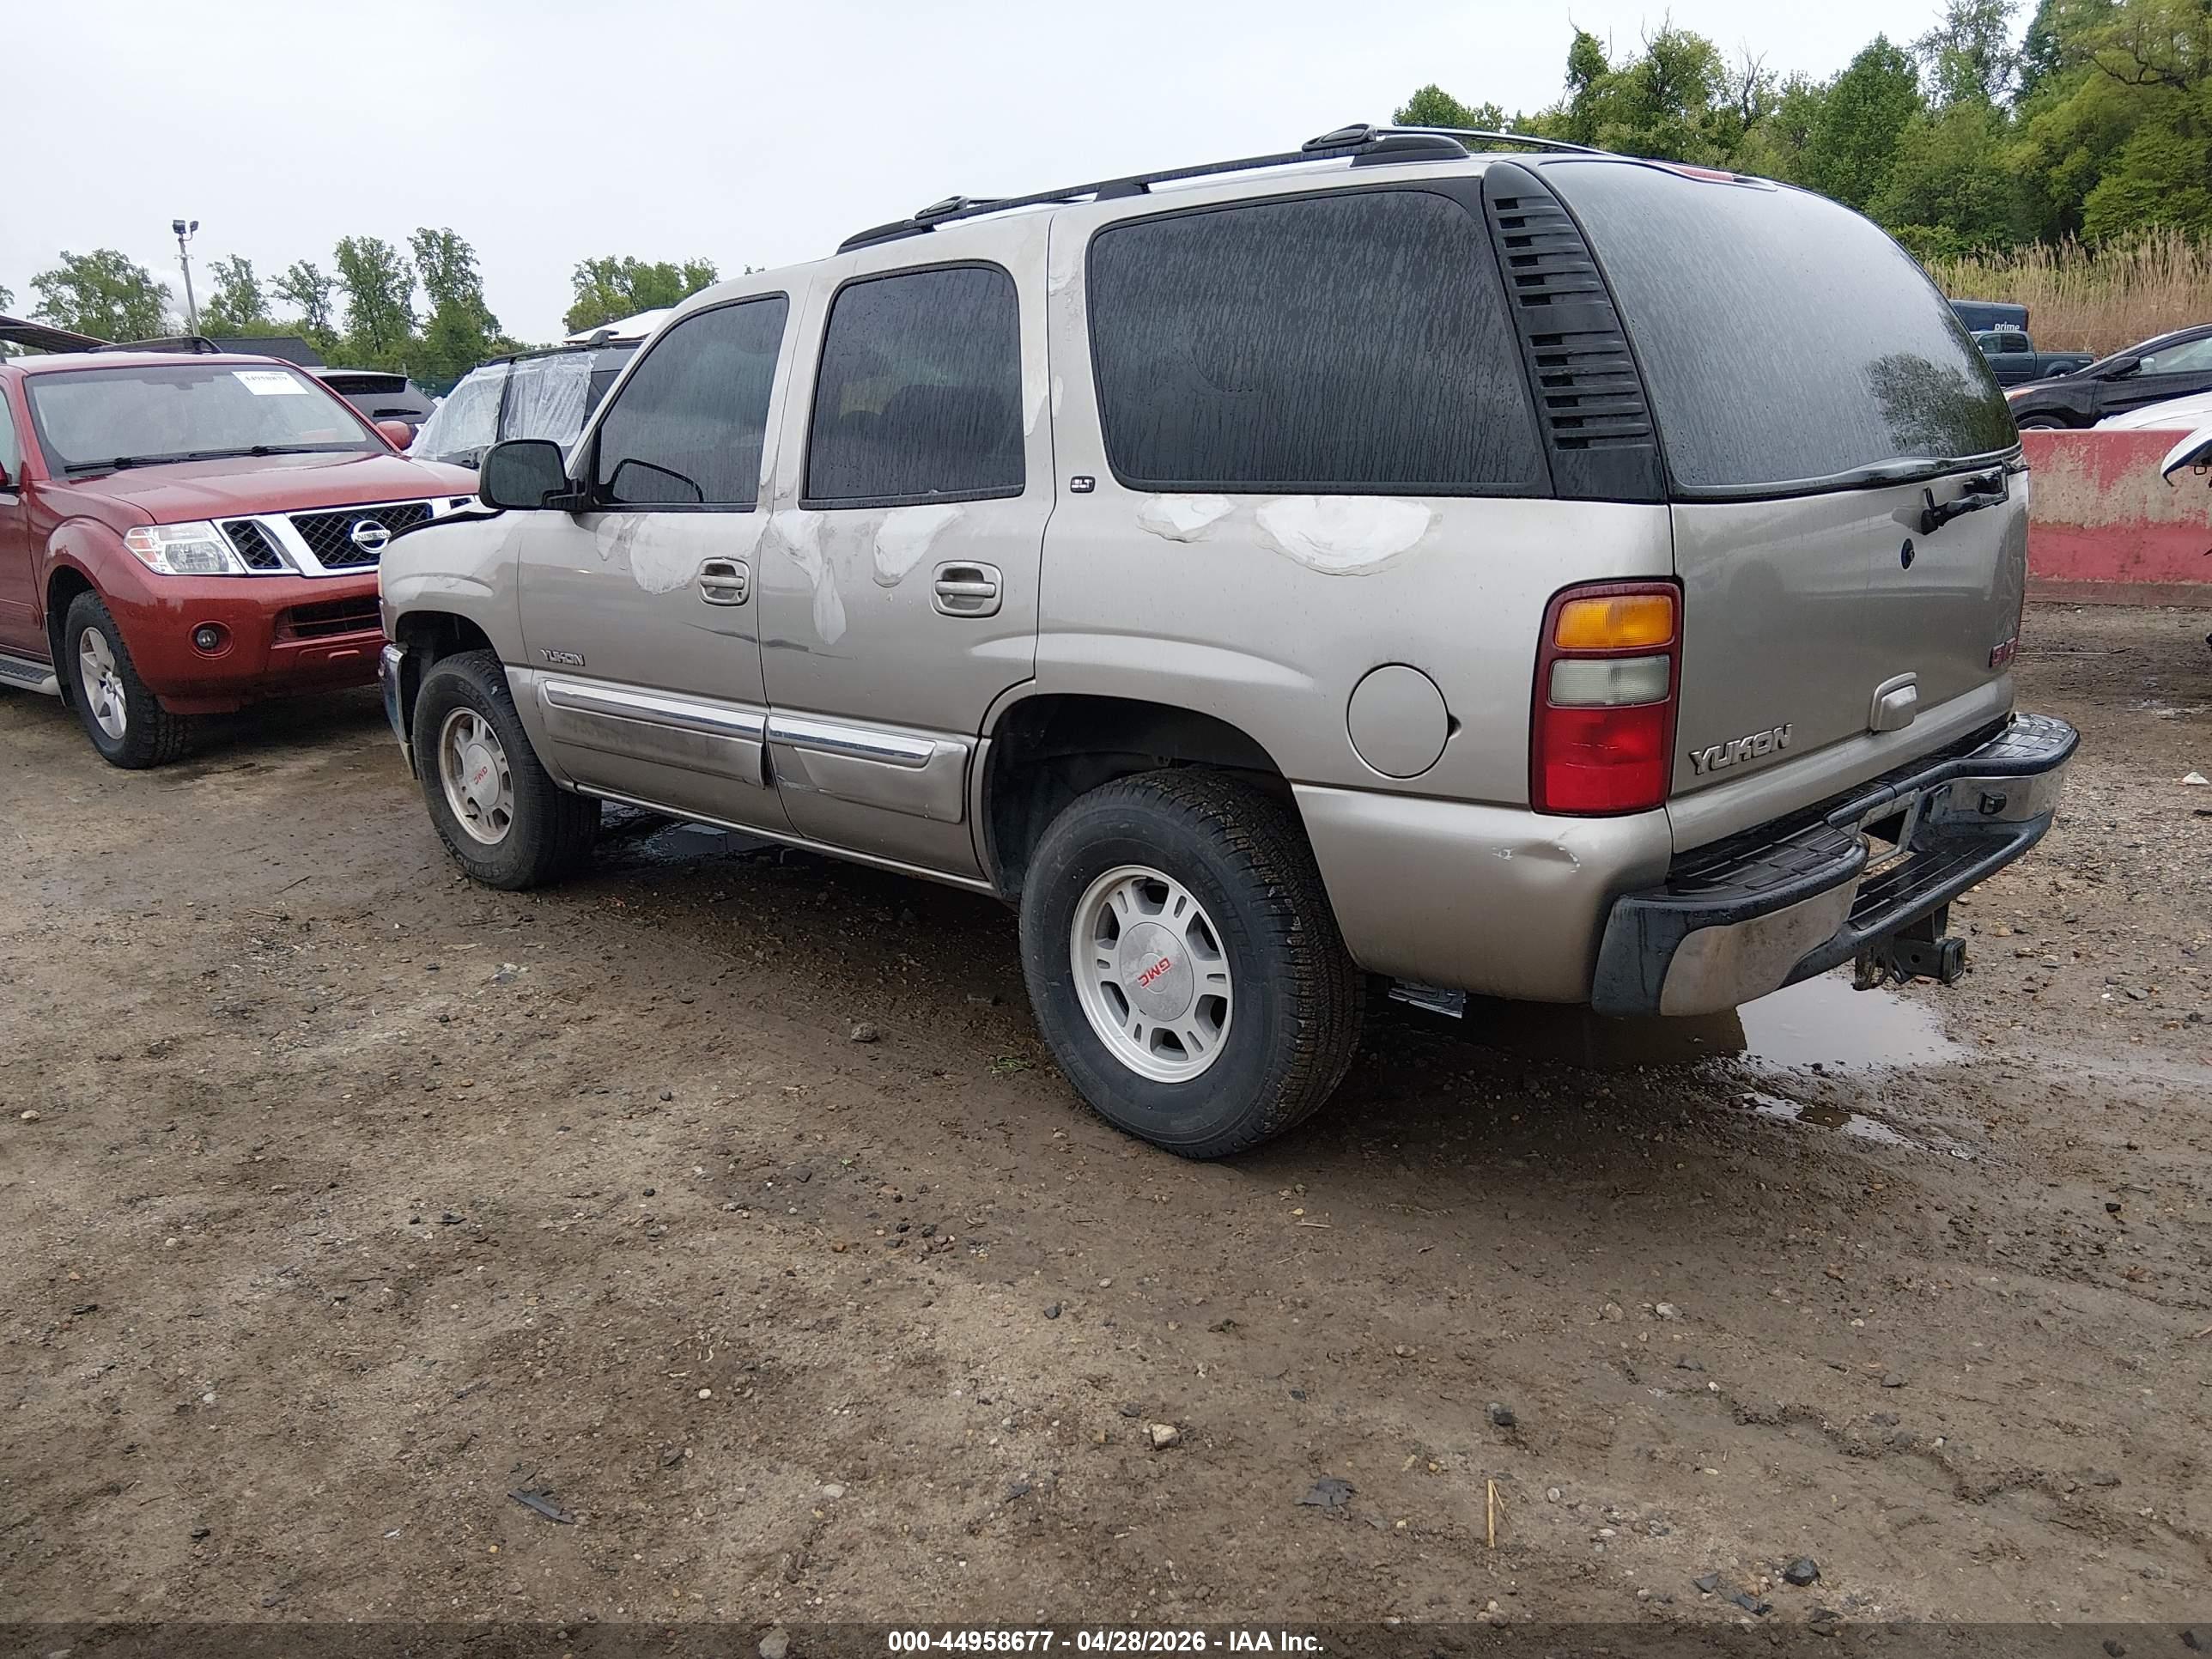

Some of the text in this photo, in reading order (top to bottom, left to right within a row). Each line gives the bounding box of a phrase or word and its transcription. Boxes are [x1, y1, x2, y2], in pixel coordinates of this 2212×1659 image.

[1994, 320, 2021, 331] prime
[539, 648, 586, 667] YUKON
[1688, 723, 1793, 775] YUKON
[1137, 957, 1171, 988] GMC
